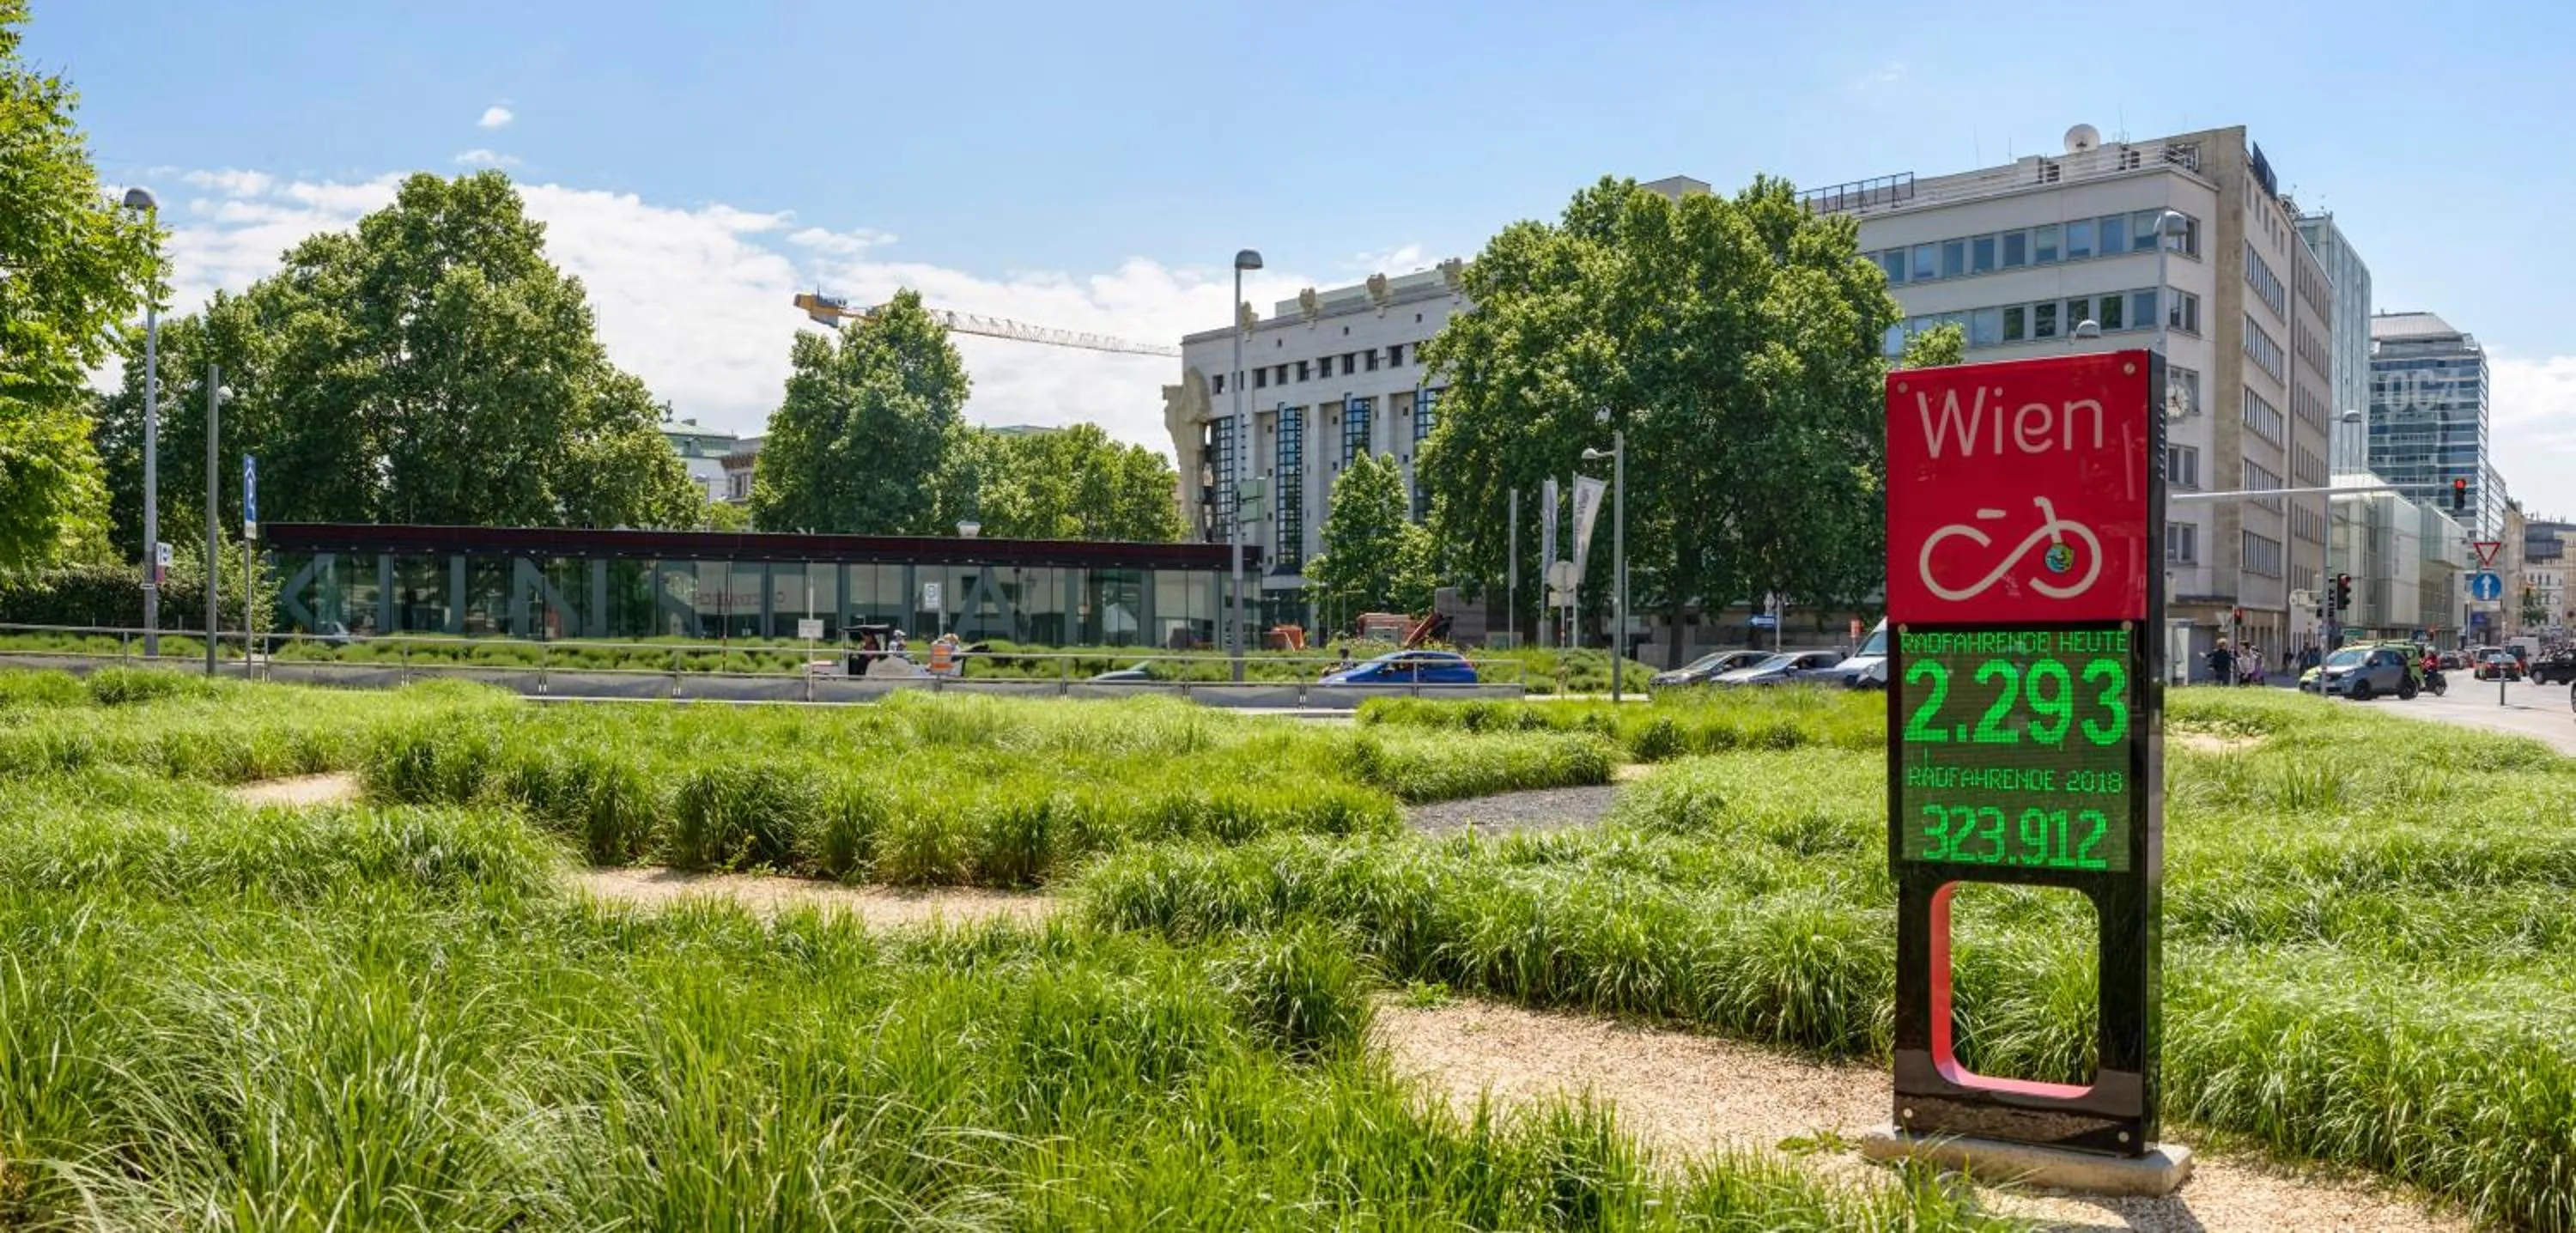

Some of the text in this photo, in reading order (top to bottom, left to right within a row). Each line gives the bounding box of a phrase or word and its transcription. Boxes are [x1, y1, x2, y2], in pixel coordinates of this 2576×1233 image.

[1917, 386, 2103, 459] Wien
[1900, 631, 2129, 654] RADFAHRENDE HEUTE
[1904, 659, 2129, 746] 2.293
[1908, 766, 2123, 793] RADFAHRENDE 2018
[1922, 801, 2108, 869] 323.912
